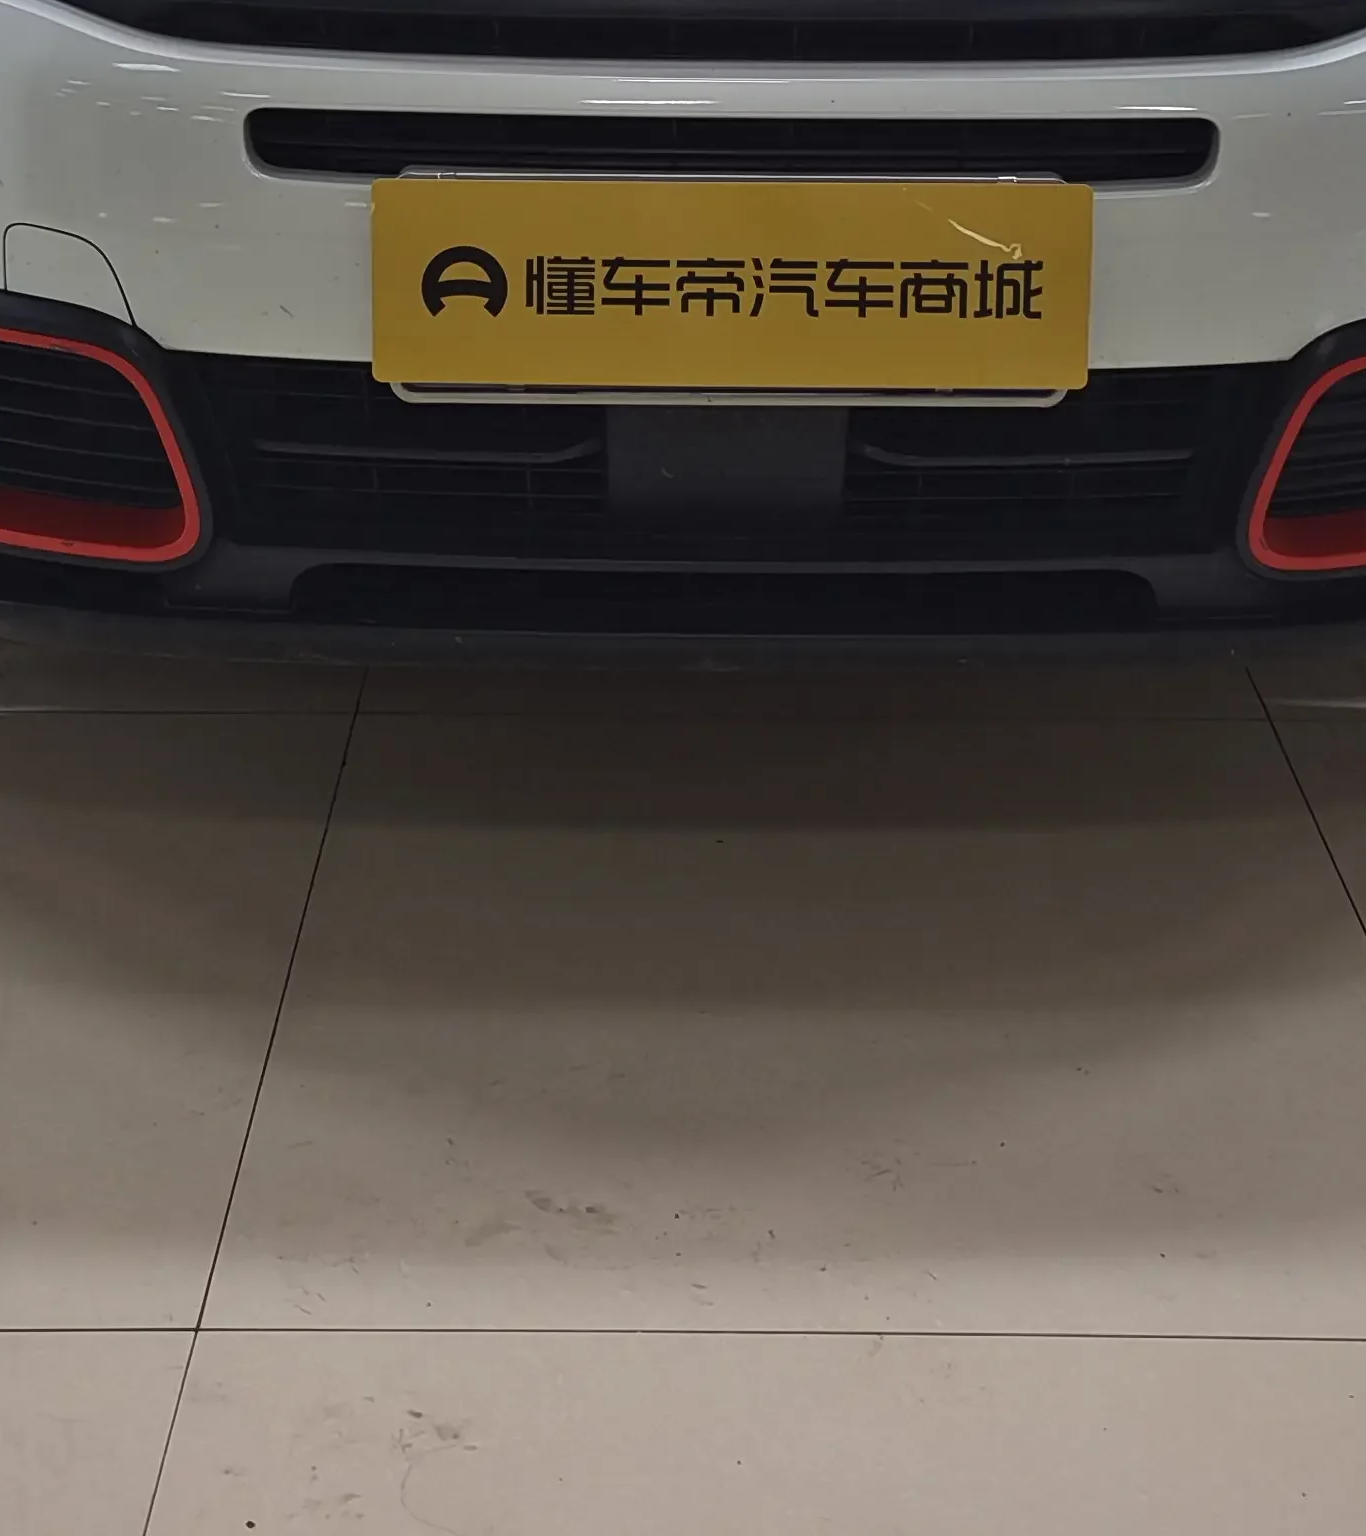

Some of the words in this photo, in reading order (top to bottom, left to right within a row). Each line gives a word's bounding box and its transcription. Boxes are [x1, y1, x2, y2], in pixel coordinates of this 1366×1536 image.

[524, 255, 1043, 319] 懂车帝汽车商城
